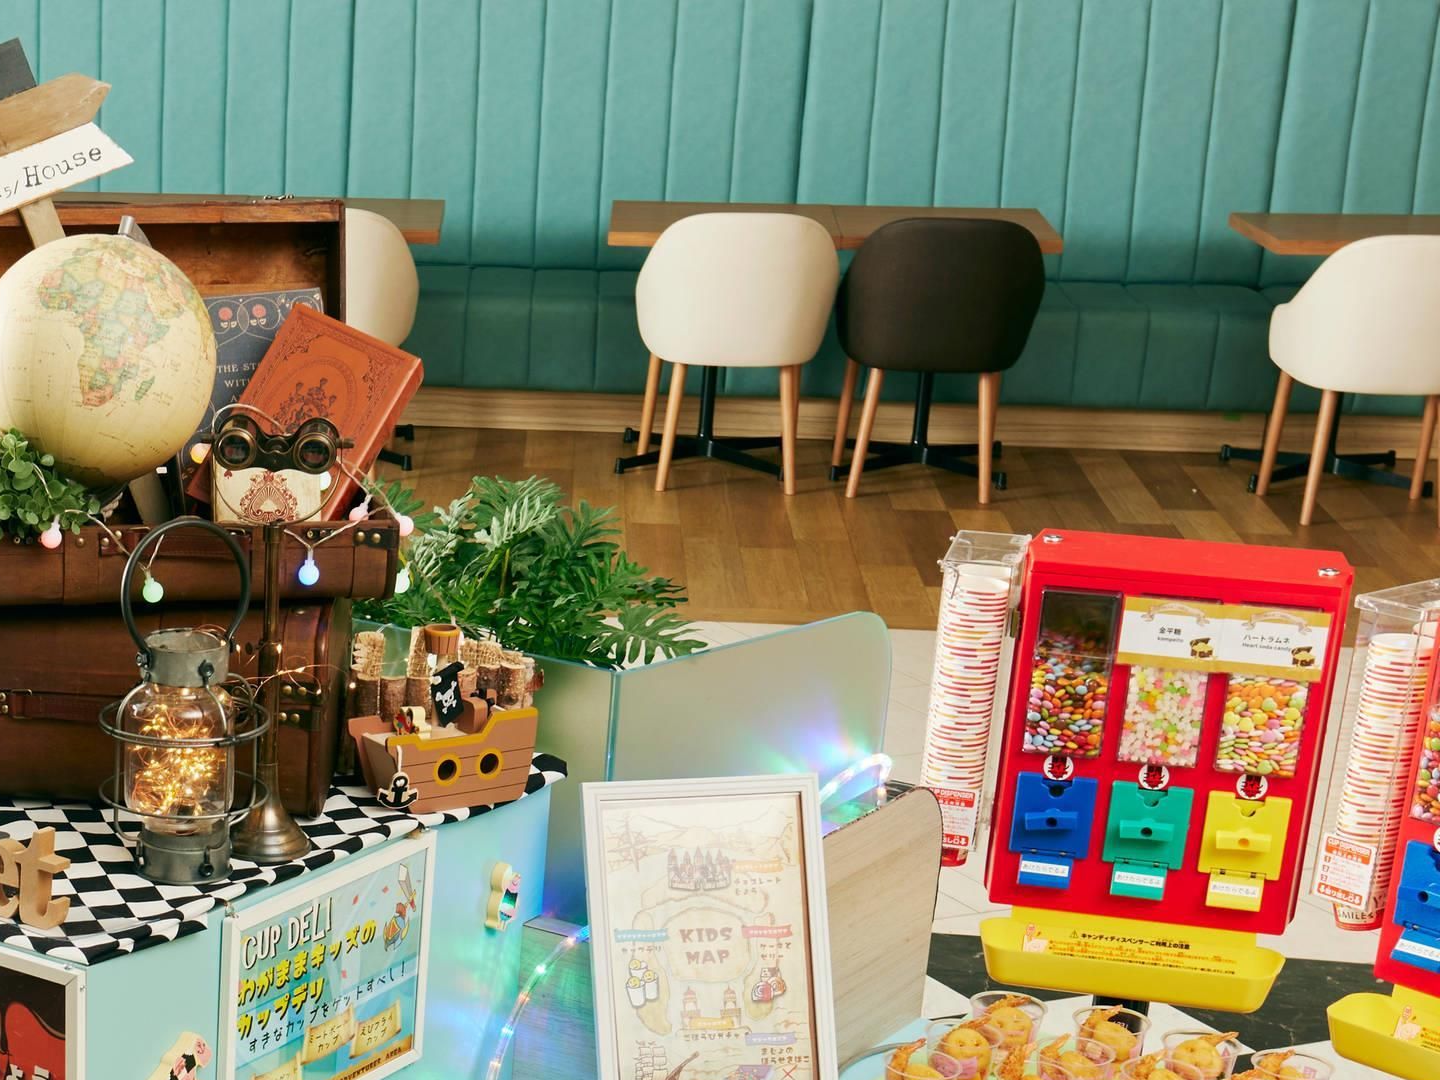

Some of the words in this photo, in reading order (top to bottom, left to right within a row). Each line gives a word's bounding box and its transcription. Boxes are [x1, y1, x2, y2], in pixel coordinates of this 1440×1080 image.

[23, 148, 101, 187] House
[217, 363, 239, 373] THE
[224, 379, 250, 388] WIT
[1243, 635, 1290, 644] ハートラムネ
[242, 925, 282, 970] CUP
[288, 897, 332, 951] DELI
[679, 927, 733, 943] KIDS
[237, 919, 376, 1007] わがままキッズの
[685, 949, 730, 965] MAP
[237, 977, 325, 1040] カップデリ
[318, 1035, 339, 1052] カップ
[366, 1028, 388, 1046] カップ
